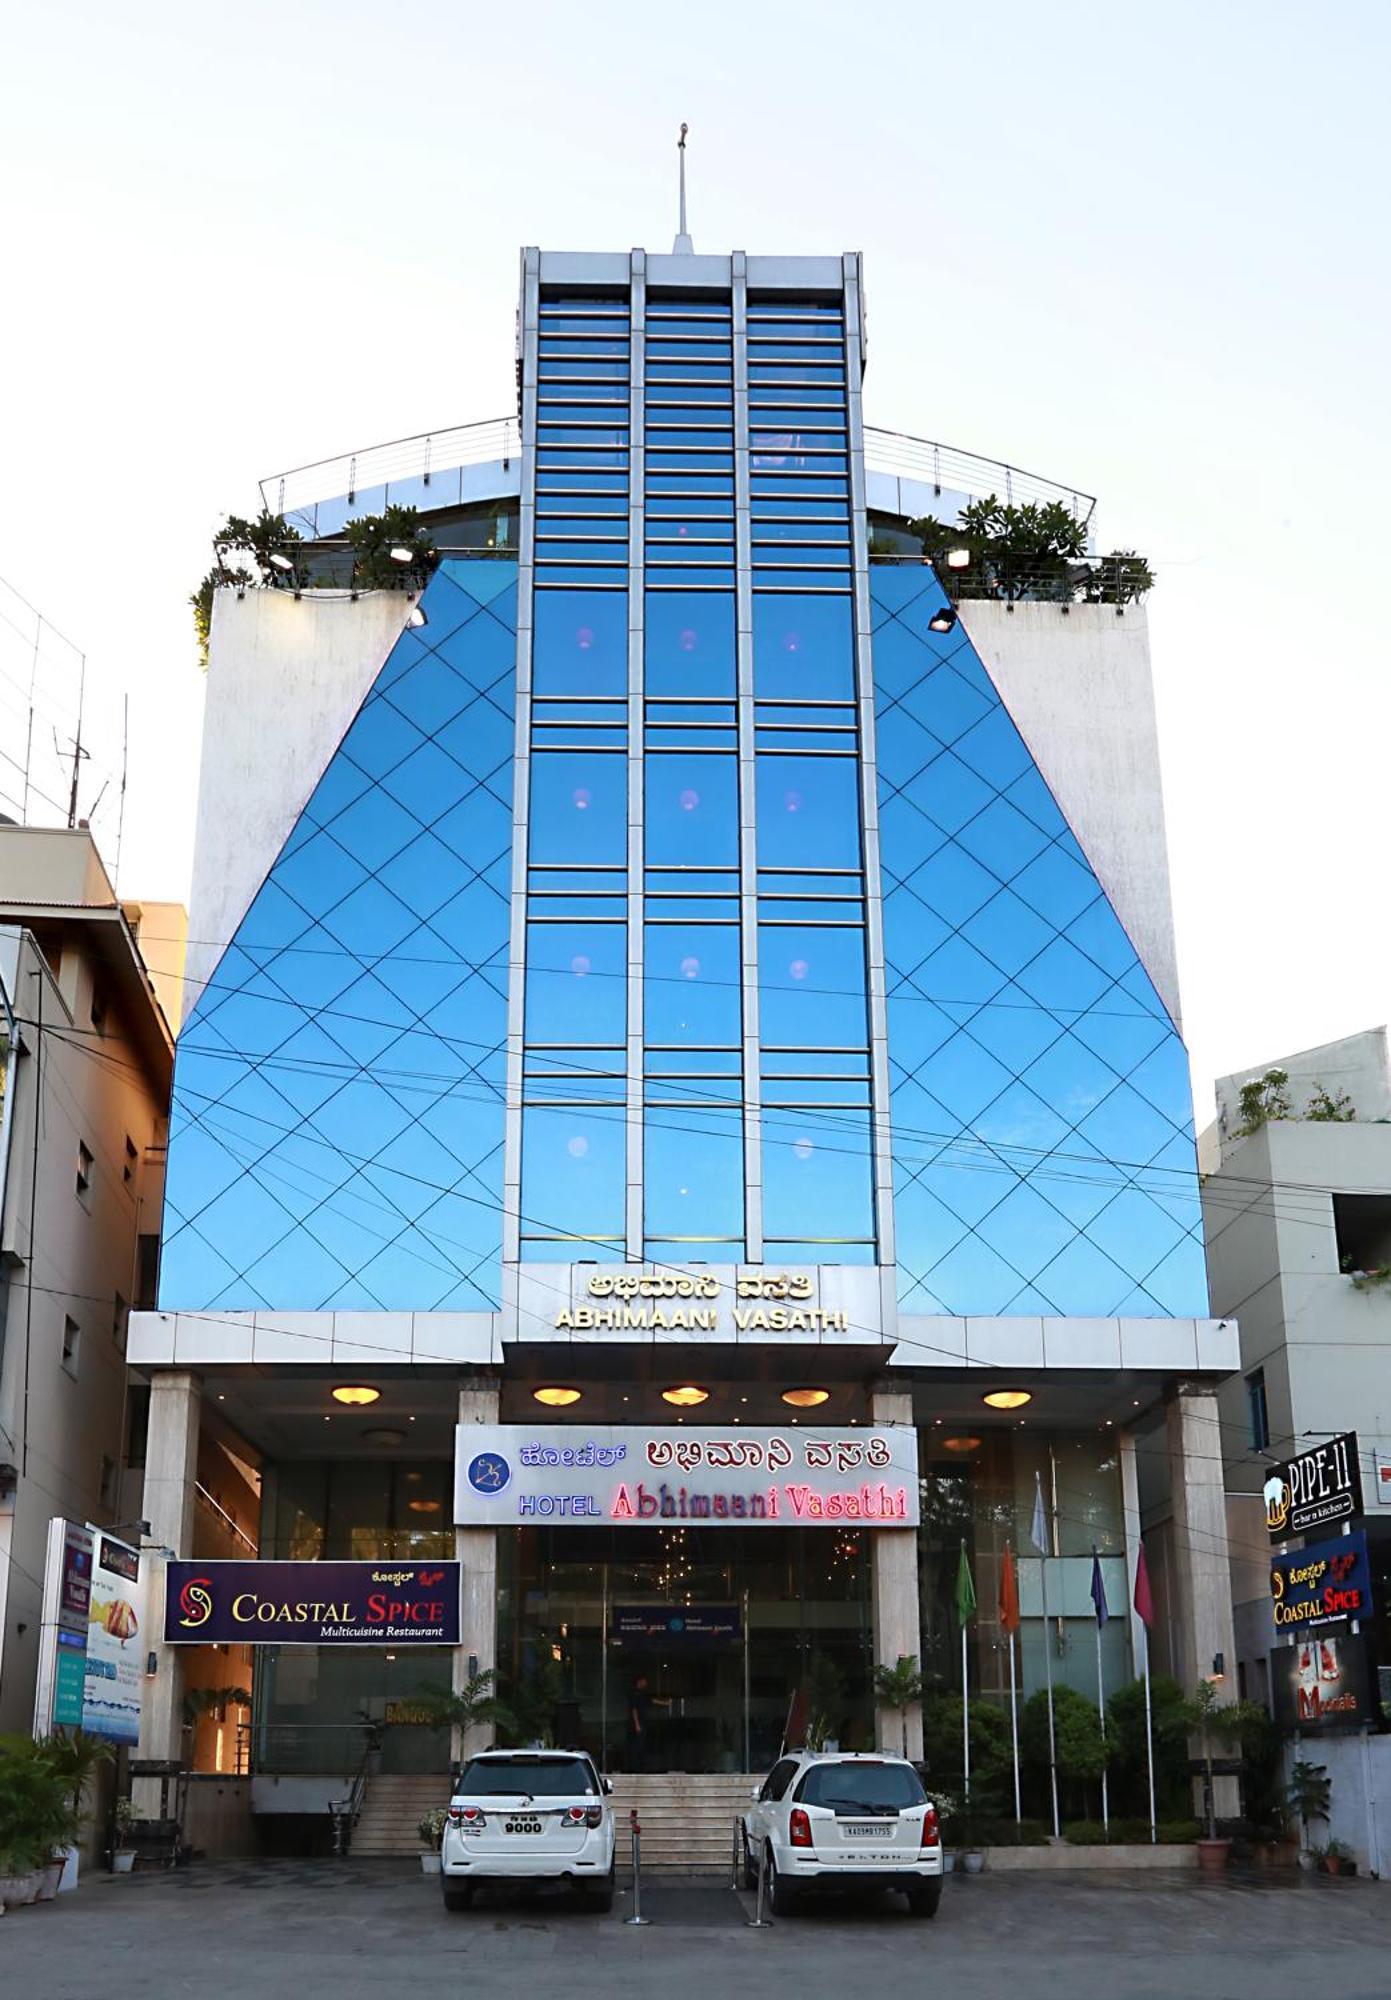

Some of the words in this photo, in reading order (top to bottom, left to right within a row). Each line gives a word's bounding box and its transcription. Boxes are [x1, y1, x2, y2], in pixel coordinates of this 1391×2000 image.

[588, 1273, 720, 1301] ಅಭಿಮಾನಿ
[737, 1273, 814, 1300] ವಸತಿ
[555, 1307, 717, 1330] ABHIMAANI
[732, 1309, 849, 1331] VASATHI
[520, 1441, 626, 1466] ಹೋಟೆಲ್
[646, 1438, 793, 1472] ಅಭಿಮಾನಿ
[804, 1437, 891, 1473] ವಸತಿ
[519, 1496, 602, 1516] HOTEL
[611, 1484, 779, 1519] Abhimaani
[785, 1483, 907, 1519] Vasathi
[1317, 1503, 1343, 1517] kitchen
[232, 1594, 357, 1622] COASTAL
[366, 1593, 444, 1623] SPICE
[1274, 1598, 1323, 1625] COASTAL
[1323, 1585, 1360, 1614] SPICE
[320, 1626, 384, 1637] Multicuisine
[386, 1626, 444, 1637] Restaurant
[506, 1822, 542, 1833] 9000
